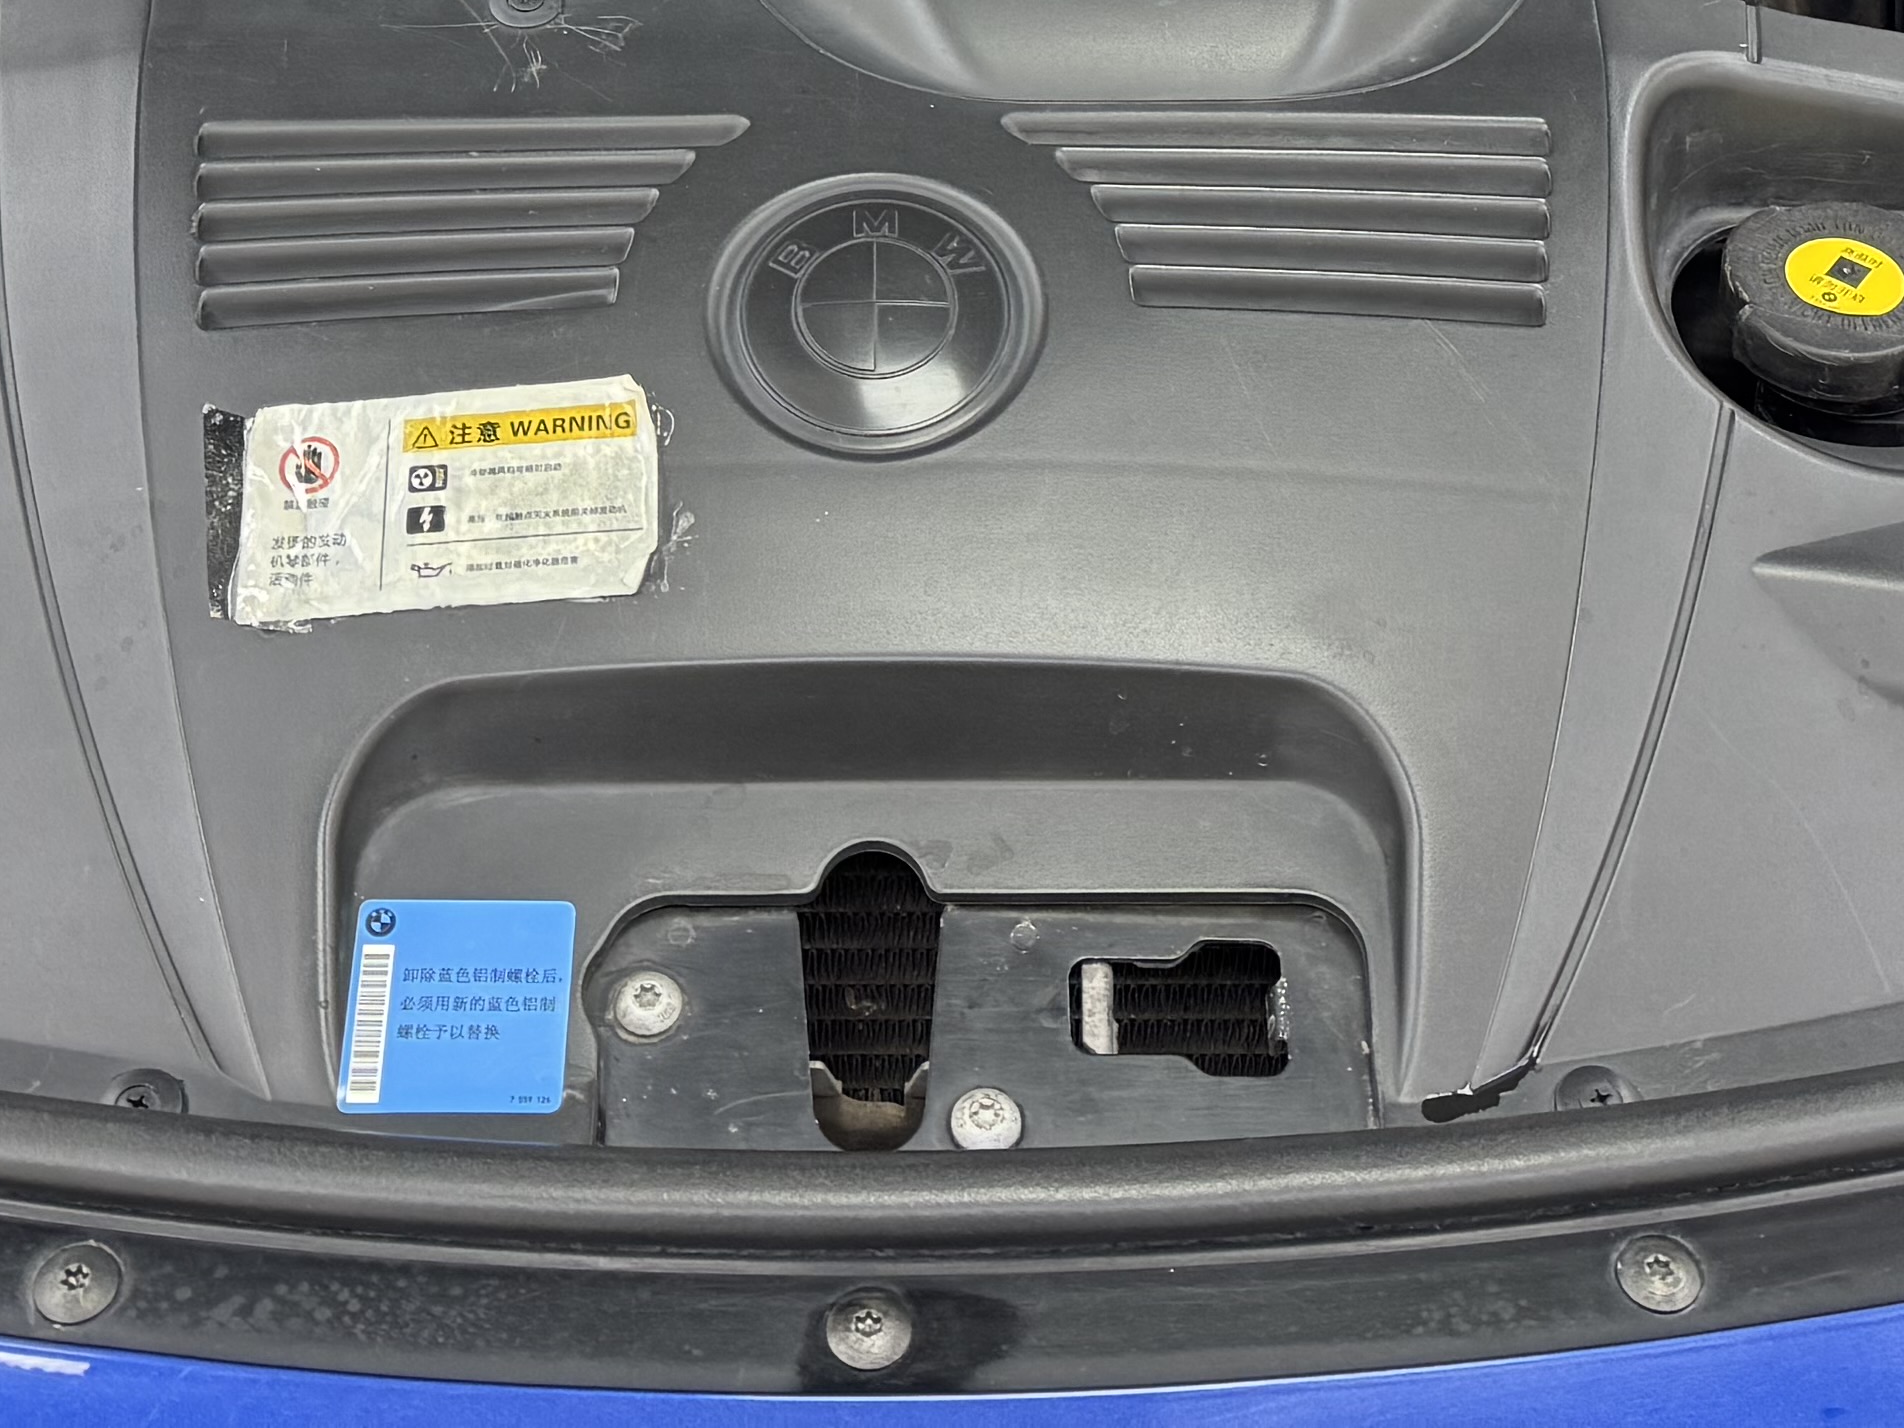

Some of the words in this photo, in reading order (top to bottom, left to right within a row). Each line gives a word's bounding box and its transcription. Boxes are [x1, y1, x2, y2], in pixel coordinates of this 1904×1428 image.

[769, 209, 986, 280] BMW
[448, 421, 501, 445] 注意
[510, 411, 632, 438] WARNING
